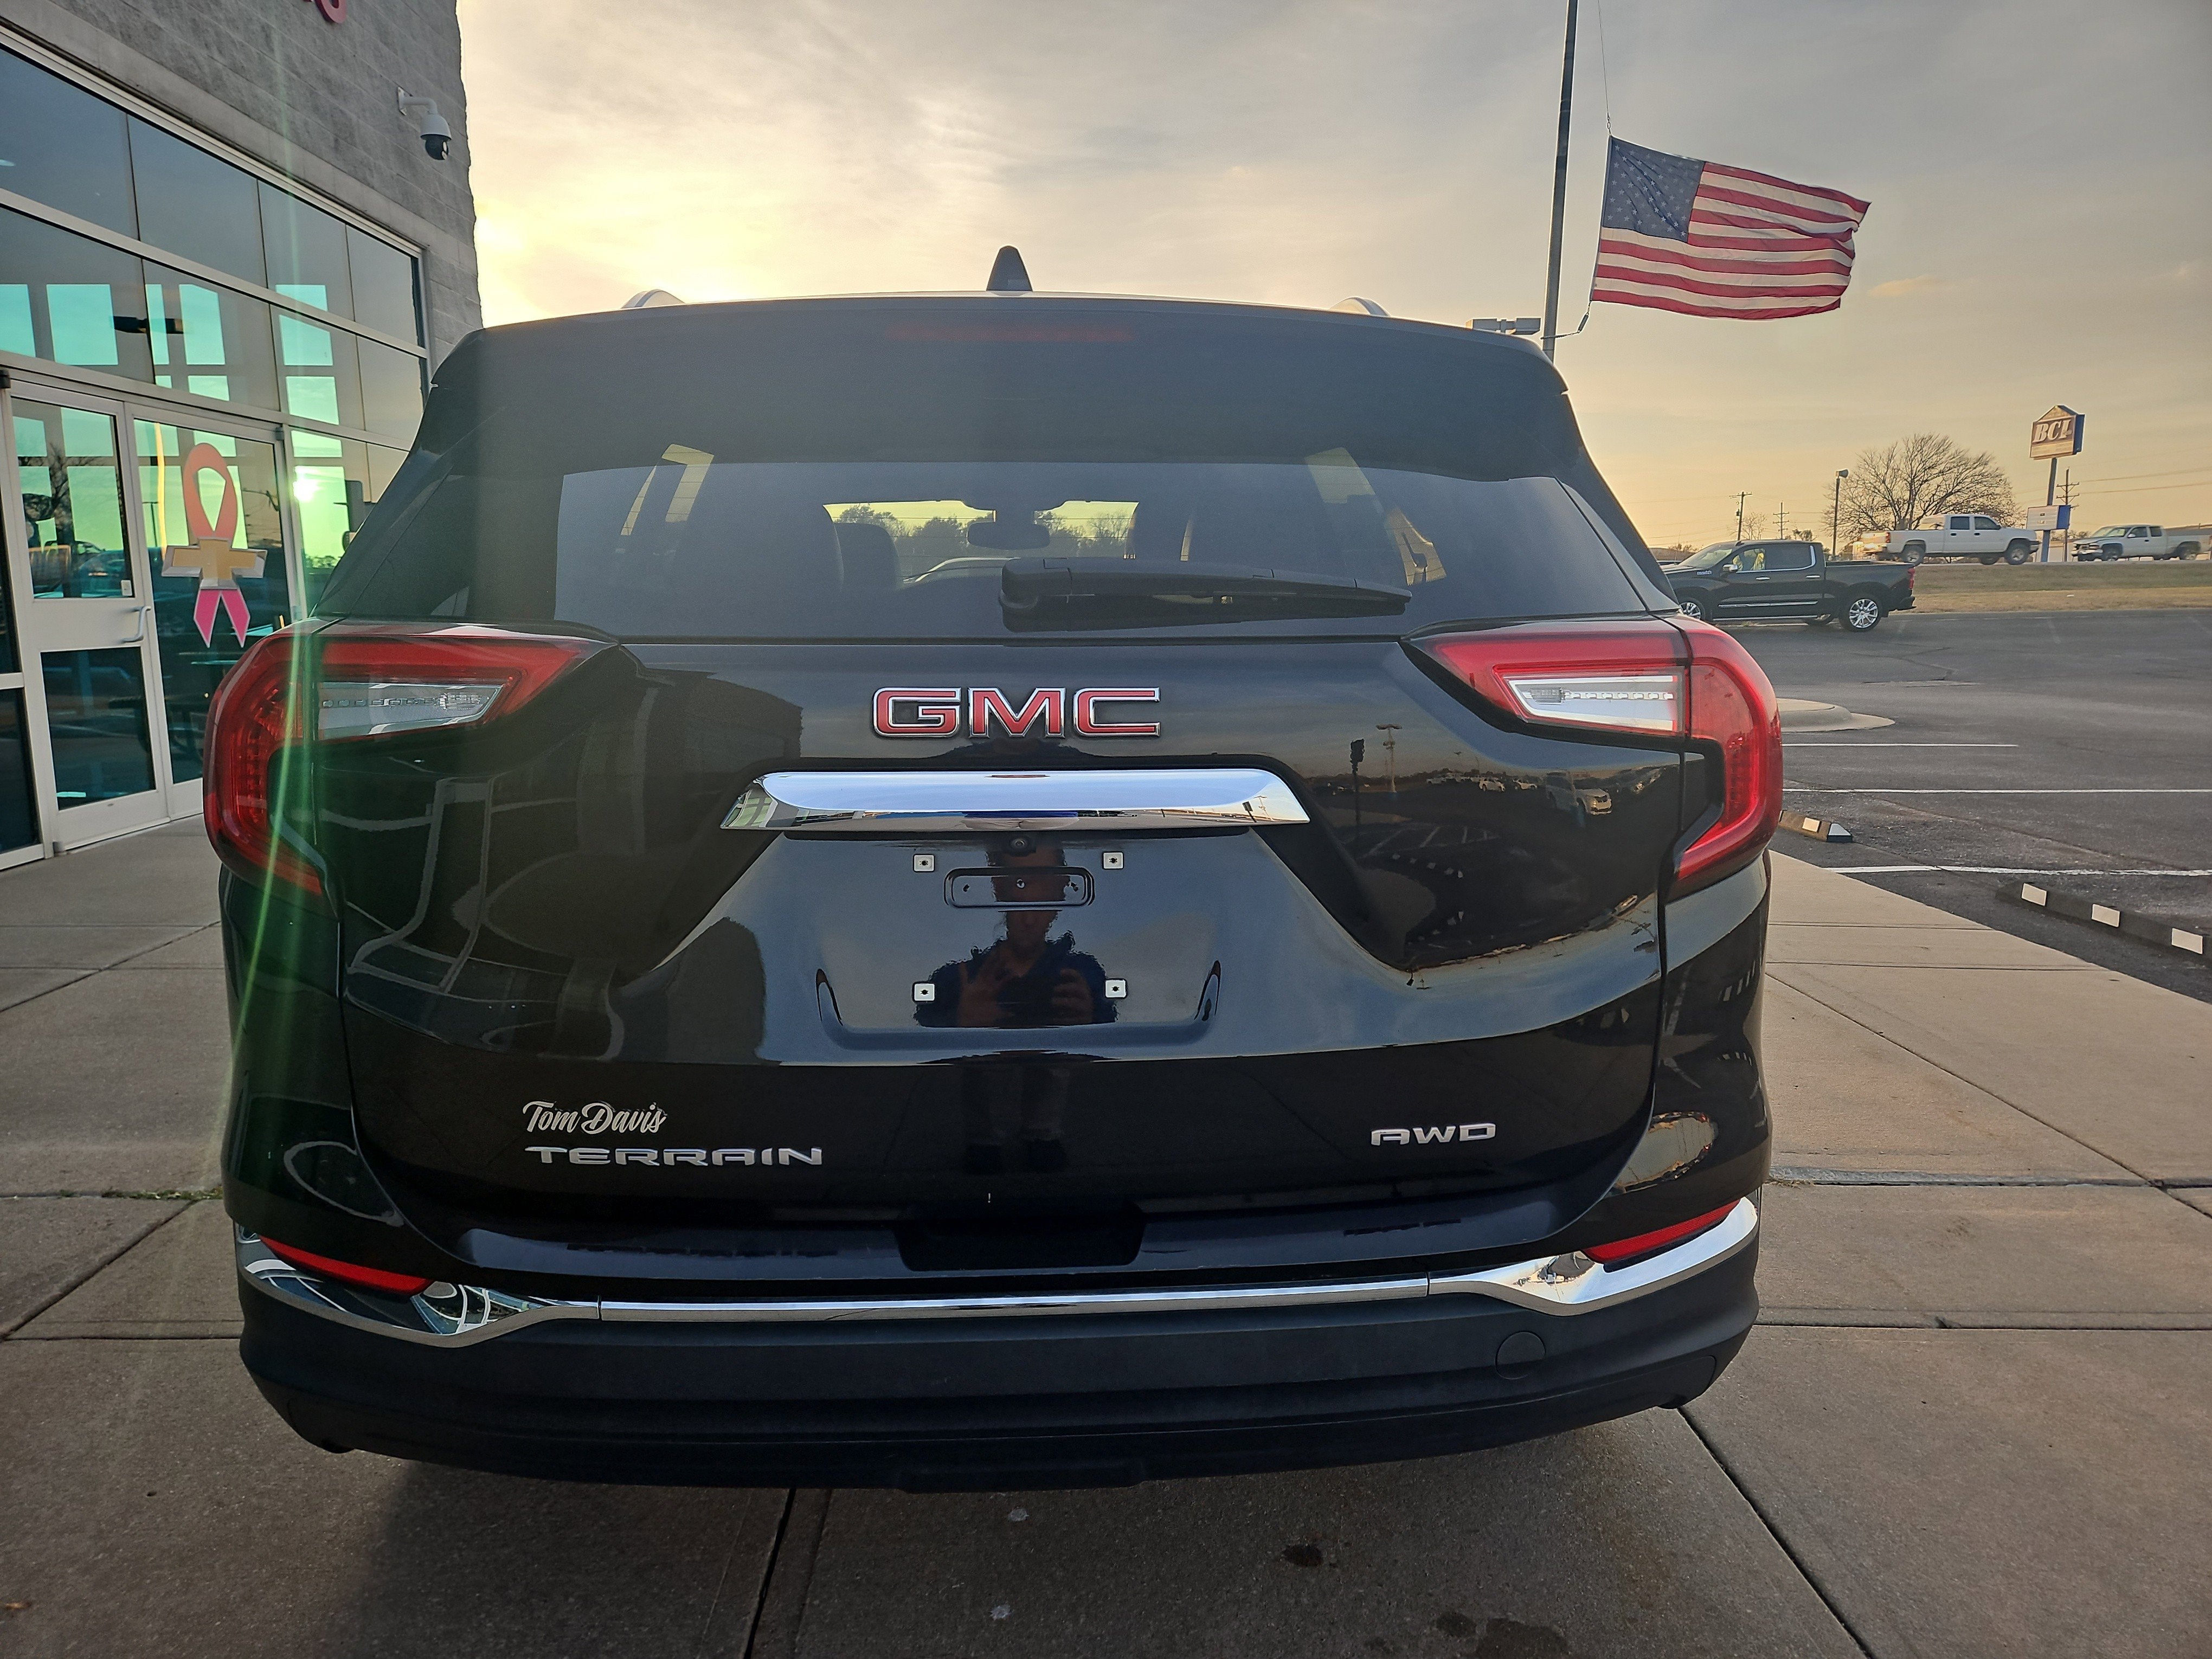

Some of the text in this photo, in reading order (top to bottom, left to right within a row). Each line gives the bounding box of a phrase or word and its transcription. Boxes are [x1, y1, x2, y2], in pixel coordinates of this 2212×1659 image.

[873, 687, 1161, 738] GMC
[523, 1101, 667, 1134] Tom Davis
[1371, 1123, 1496, 1146] AWD
[524, 1146, 822, 1166] TERRAIN
